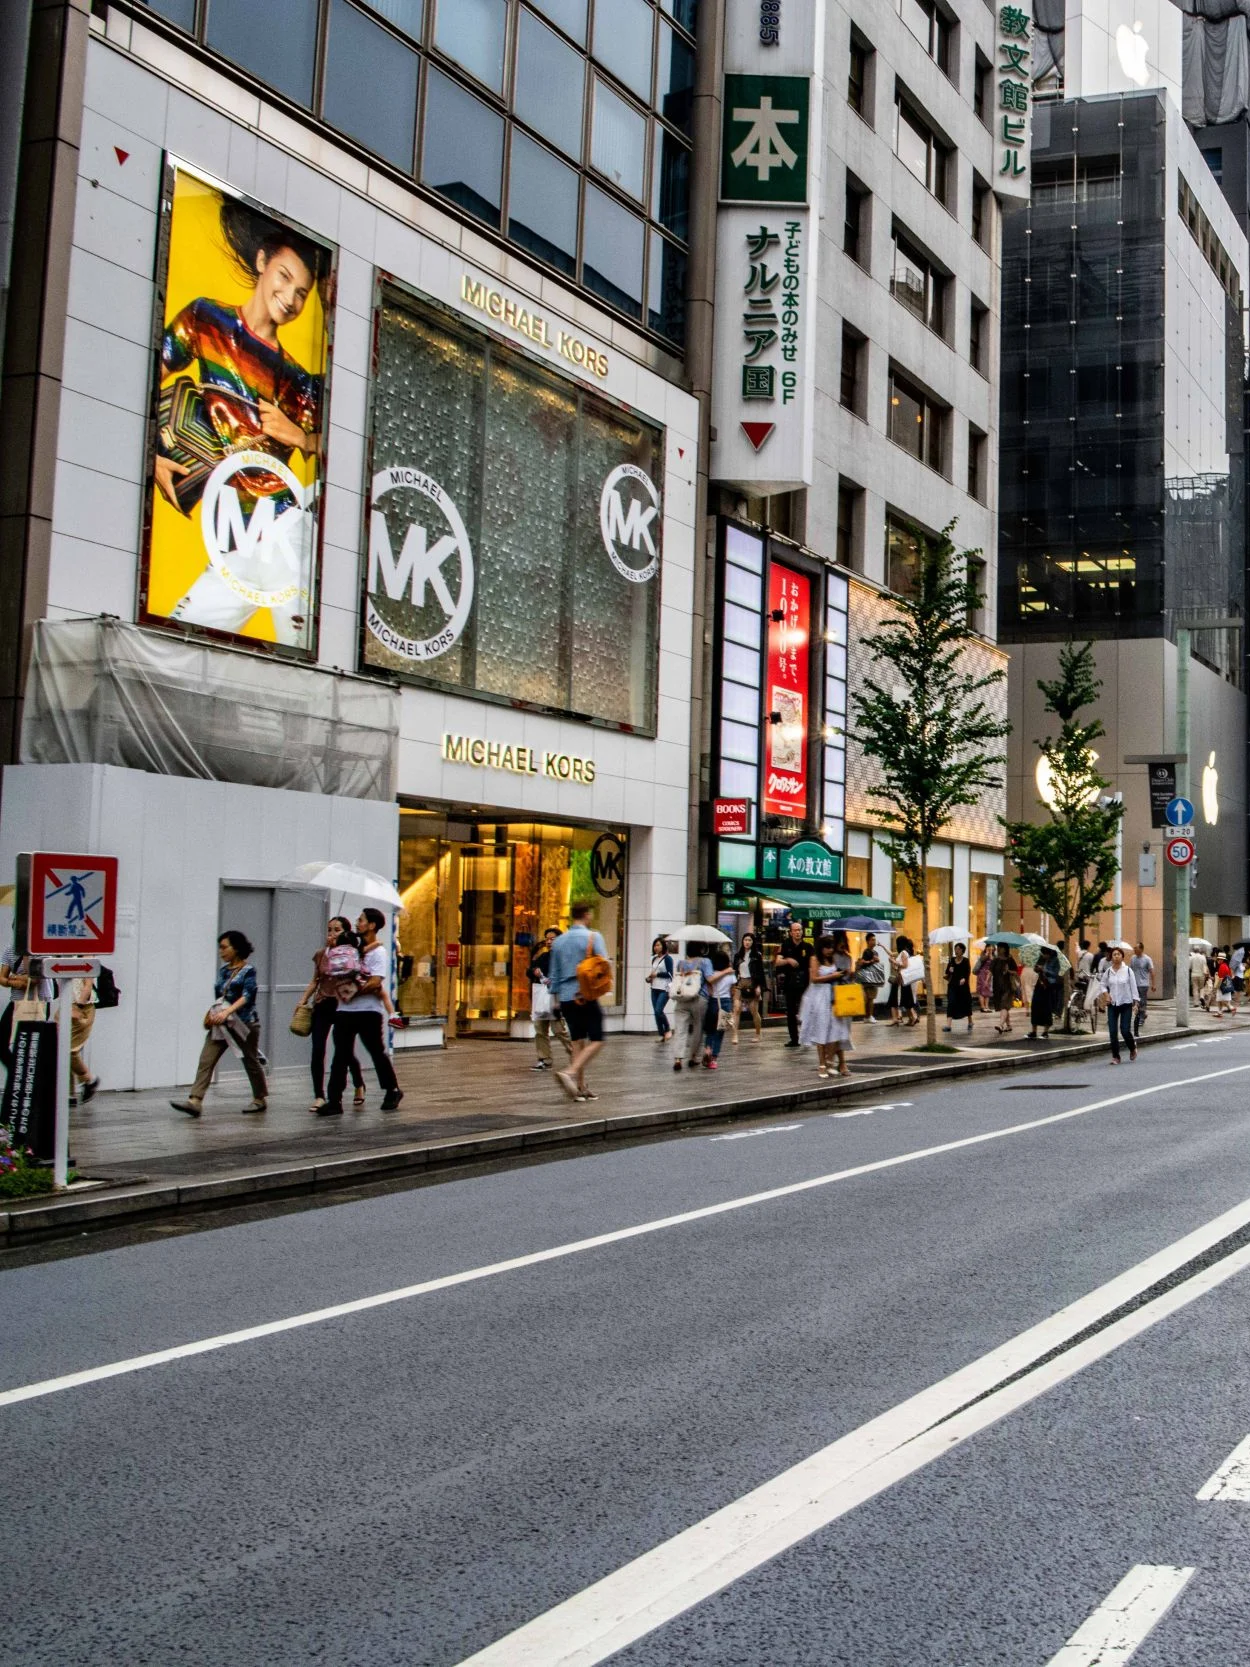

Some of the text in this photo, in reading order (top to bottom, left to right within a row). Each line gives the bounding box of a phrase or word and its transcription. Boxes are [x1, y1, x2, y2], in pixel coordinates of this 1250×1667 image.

[999, 5, 1031, 177] 教文館ビル
[730, 96, 800, 182] 本
[460, 273, 610, 379] MICHAEL KORS
[741, 225, 782, 402] ナルニア国
[781, 221, 803, 405] 子どもの本のみせ 6F
[389, 470, 443, 503] MICHAEL
[216, 484, 302, 572] MK
[609, 488, 658, 557] MK
[367, 508, 459, 617] MK
[368, 612, 455, 657] MICHAEL KORS
[442, 733, 597, 784] MICHAEL KORS
[716, 803, 747, 815] BOOKS
[596, 850, 625, 880] MK
[764, 850, 777, 863] 本
[786, 854, 833, 878] 本の教文館
[1172, 846, 1189, 859] 50
[46, 923, 88, 938] 横断禁止
